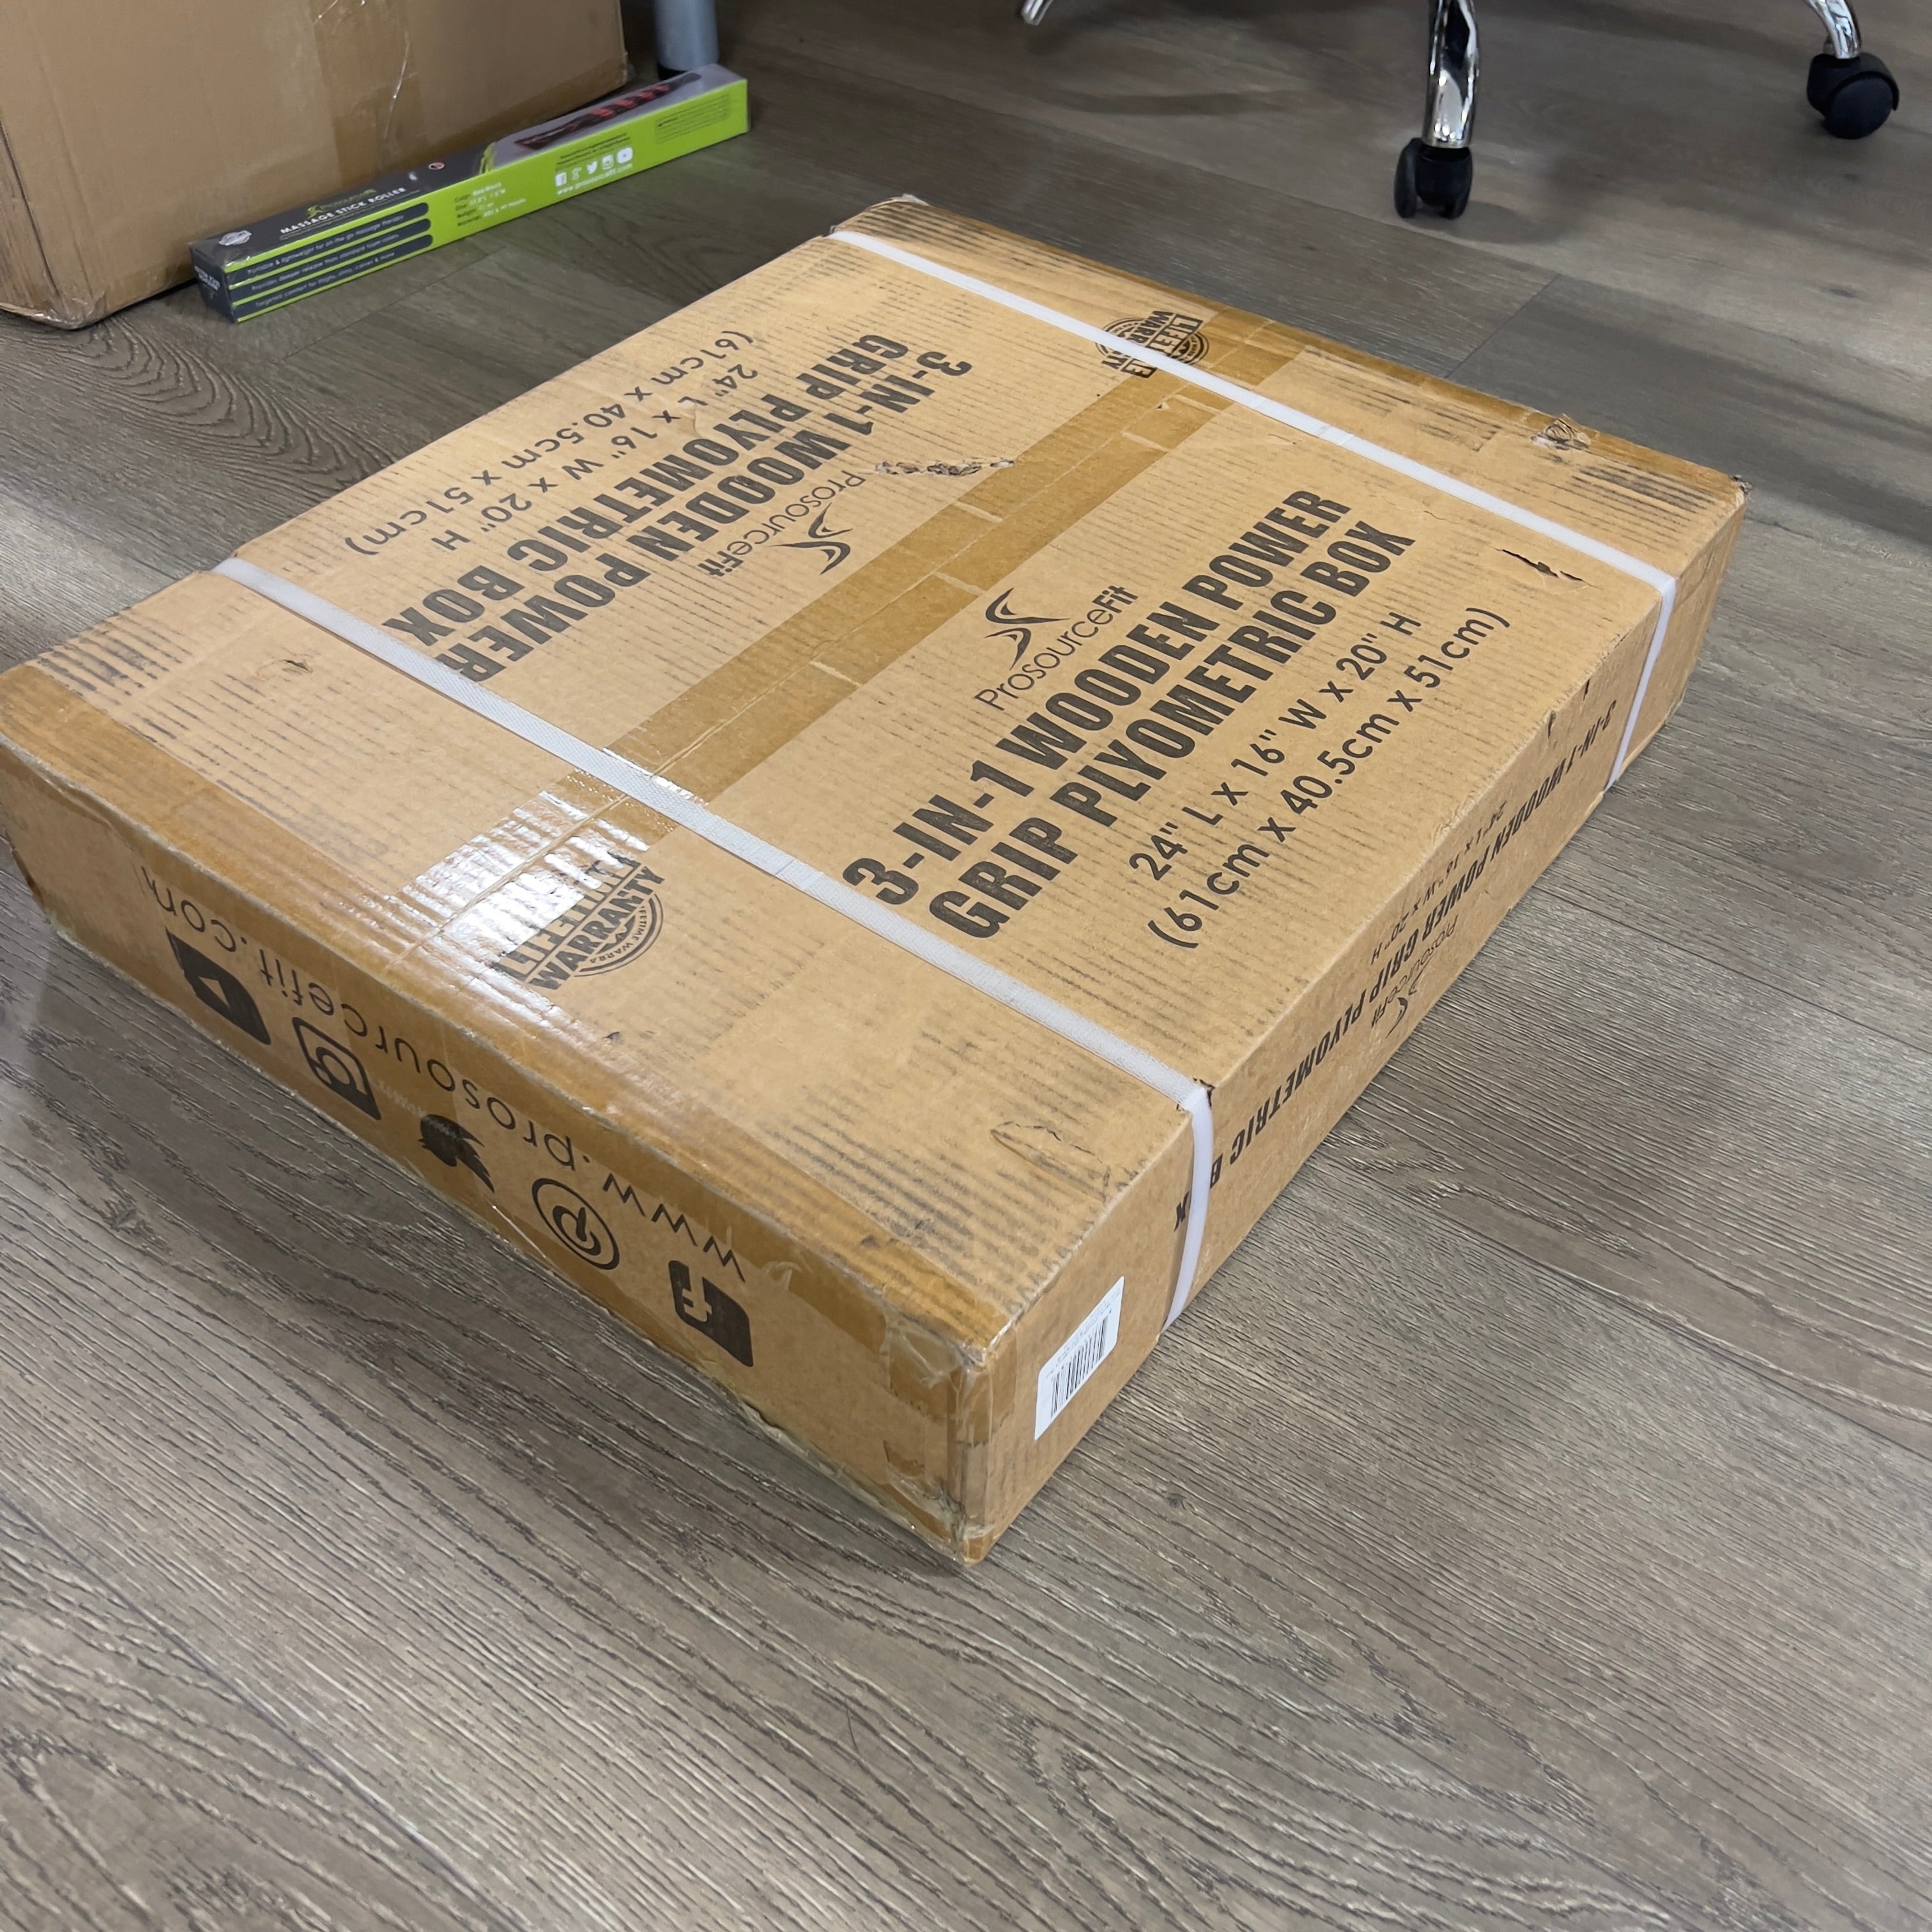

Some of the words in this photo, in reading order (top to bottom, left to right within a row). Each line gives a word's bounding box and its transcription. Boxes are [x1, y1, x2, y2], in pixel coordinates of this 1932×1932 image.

[280, 212, 335, 234] MASSAGE
[335, 201, 367, 214] STICK
[367, 187, 407, 203] ROLLER
[649, 328, 756, 388] (61cm
[796, 334, 908, 400] GRIP
[1101, 310, 1174, 370] WARRTY
[1124, 314, 1201, 377] LIFETE
[623, 386, 654, 403] x
[652, 408, 683, 424] x
[679, 390, 708, 408] L
[707, 362, 760, 404] 24"
[826, 350, 972, 435] 3-IN-1
[507, 404, 628, 473] 40.5cm
[561, 455, 606, 480] W
[610, 425, 659, 462] 16"
[470, 469, 509, 488] x
[479, 492, 533, 533] 20"
[507, 392, 811, 572] PLYOMETRIC
[528, 475, 560, 493] x
[643, 424, 852, 562] WOODEN
[343, 485, 475, 556] 51cm)
[431, 528, 471, 552] H
[698, 470, 866, 577] ProsourceFit
[381, 565, 526, 647] BOX
[434, 552, 652, 682] POWER
[976, 585, 1138, 712] ProsourceFit
[843, 760, 1034, 905] 3-IN-1
[996, 601, 1220, 770] WOODEN
[1182, 490, 1351, 611] POWER
[929, 816, 1078, 939] GRIP
[1050, 589, 1337, 827] PLYOMETRIC
[1301, 520, 1416, 597] BOX
[1129, 822, 1183, 881] 24"
[1181, 806, 1222, 827] L
[1212, 781, 1248, 804] x
[1232, 728, 1287, 778] 16"
[1278, 698, 1328, 731] W
[1318, 680, 1354, 703] x
[1337, 634, 1390, 681] 20"
[1381, 611, 1422, 636] H
[1565, 699, 1617, 774] 3-IN-1
[1147, 843, 1273, 949] (61cm
[1259, 816, 1297, 841] x
[1278, 712, 1397, 817] 40.5cm
[1387, 689, 1423, 712] x
[1406, 606, 1510, 692] 51cm)
[1490, 757, 1567, 862] WOODEN
[527, 865, 665, 990] WARRANTY
[1422, 844, 1491, 941] POWER
[1369, 928, 1419, 1003] GRIP
[1371, 942, 1382, 966] H
[141, 865, 747, 1284] www.prosourcefit.com
[1229, 988, 1367, 1165] PLYOMETRIC
[1174, 1153, 1223, 1232] BX
